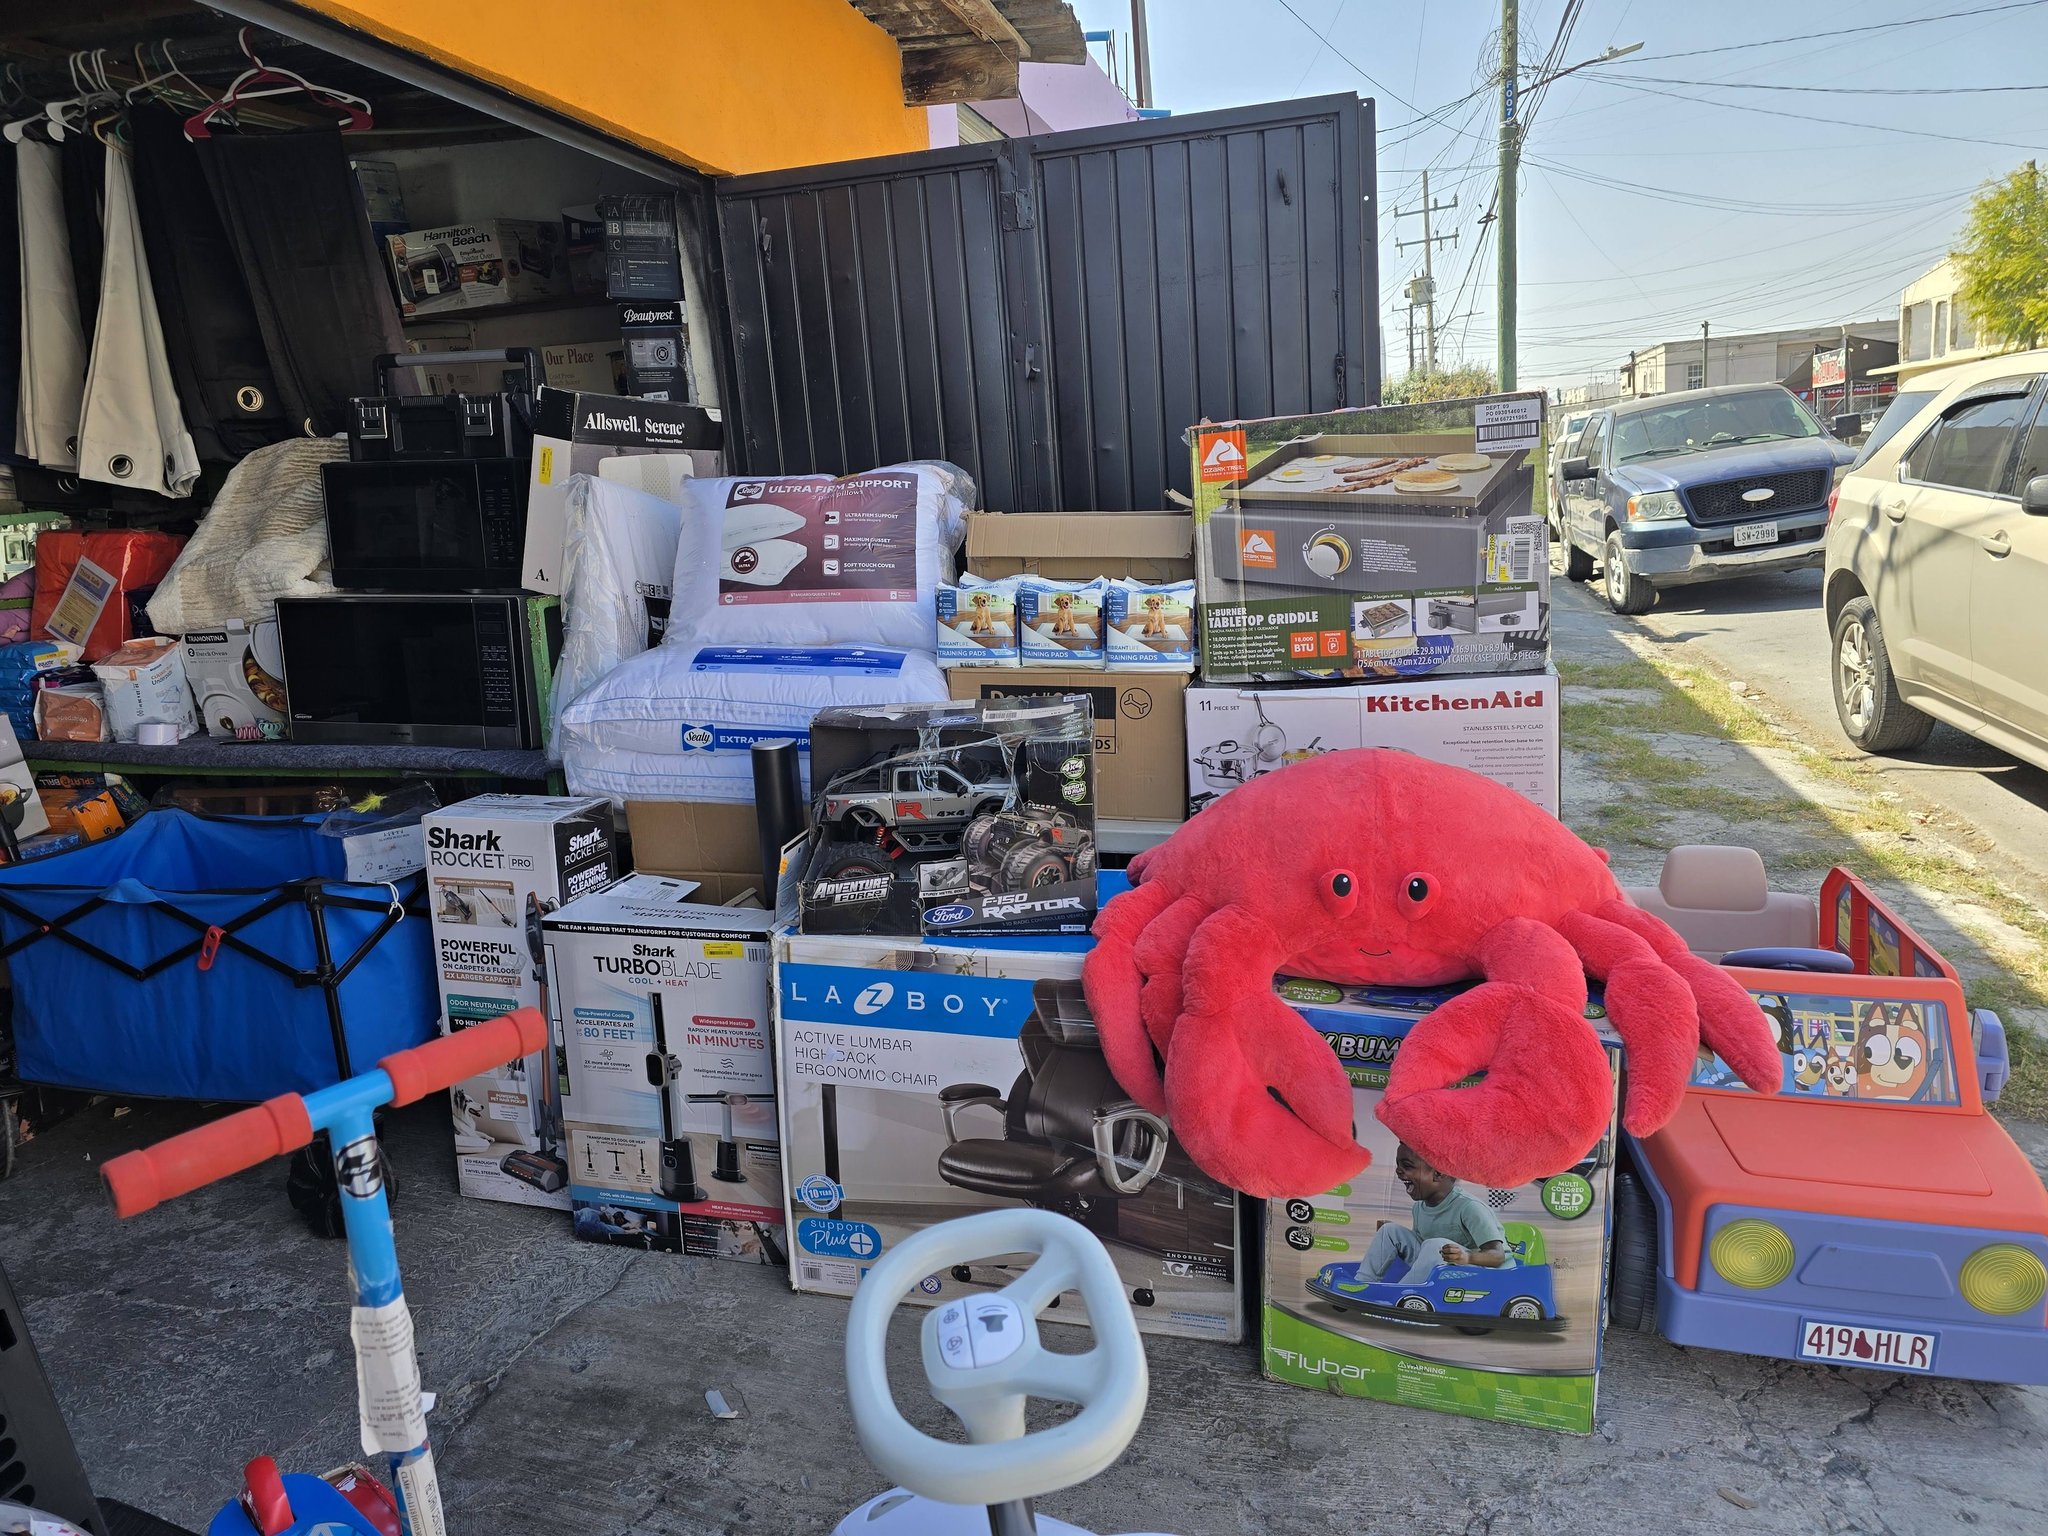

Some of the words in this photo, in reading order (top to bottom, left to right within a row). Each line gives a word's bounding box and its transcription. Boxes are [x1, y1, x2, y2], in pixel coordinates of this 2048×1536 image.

[423, 226, 475, 242] Hamilton
[612, 222, 620, 234] B
[452, 232, 491, 247] Beach
[624, 308, 673, 323] Beautyrest
[546, 350, 564, 366] Our
[567, 348, 594, 364] Place
[583, 412, 641, 433] Allswell.
[645, 418, 683, 436] Serene
[768, 485, 812, 494] ULTRA
[848, 479, 912, 488] SUPPORT
[1736, 528, 1776, 542] LSW-2998
[1208, 607, 1247, 617] 1-BURNER
[1208, 614, 1265, 629] TABLETOP
[1267, 611, 1319, 625] GRIDDLE
[187, 635, 225, 643] TRAMONTINA
[1294, 643, 1314, 653] BTU
[1420, 646, 1435, 655] 29.8
[1488, 643, 1499, 651] 8.9
[1507, 642, 1514, 651] H
[1388, 657, 1403, 666] 42.9
[1419, 656, 1432, 665] 22.6
[1452, 654, 1472, 663] CARRY
[1492, 652, 1513, 661] TOTAL
[1518, 651, 1539, 660] PIECES
[1199, 700, 1212, 712] 11
[1366, 690, 1544, 713] KitchenAid
[686, 731, 712, 744] Sealy
[719, 735, 754, 745] EXTRA
[895, 802, 929, 820] R
[428, 826, 502, 852] Shark
[569, 827, 602, 852] Shark
[431, 850, 505, 869] ROCKET
[512, 858, 531, 868] PRO
[564, 843, 596, 866] ROCKET
[568, 861, 608, 887] POWERFUL
[570, 871, 607, 895] CLEANING
[812, 876, 890, 900] ADVENTURE
[839, 888, 883, 902] FORCE
[982, 892, 1029, 907] F-150
[621, 904, 688, 915] Year-round
[689, 909, 742, 919] comfort
[932, 907, 965, 924] Ford
[982, 896, 1087, 920] RAPTOR
[631, 911, 673, 919] starts
[675, 913, 707, 921] here.
[1030, 916, 1065, 924] CONTROLLED
[1066, 912, 1089, 920] VEHICLE
[626, 927, 667, 936] TRANSFORMS
[681, 930, 720, 938] CUSTOMIZED
[441, 939, 517, 955] POWERFUL
[632, 943, 675, 958] Shark
[442, 951, 500, 966] SUCTION
[454, 963, 485, 972] CARPETS
[593, 956, 723, 980] TURBOBLADE
[456, 973, 482, 981] LARGER
[628, 977, 654, 985] COOL
[665, 979, 689, 987] HEAT
[449, 999, 469, 1007] ODOR
[471, 1000, 516, 1010] NEUTRALIZER
[575, 1019, 621, 1027] ACCELERATES
[584, 1027, 600, 1038] 80
[603, 1028, 636, 1041] FEET
[794, 1030, 845, 1046] ACTIVE
[850, 1034, 913, 1052] LUMBAR
[687, 1034, 701, 1045] IN
[705, 1035, 765, 1050] MINUTES
[796, 1063, 887, 1082] ERGONOMIC
[892, 1070, 938, 1087] CHAIR
[808, 1189, 819, 1199] 10
[1551, 1192, 1584, 1206] LED
[810, 1219, 866, 1233] support
[809, 1230, 848, 1250] Plus
[1166, 1252, 1208, 1262] ENDORSED
[1807, 1325, 1852, 1356] 419
[1874, 1333, 1929, 1367] HLR
[1284, 1352, 1371, 1380] flybar
[1406, 1363, 1446, 1375] WARNING!
